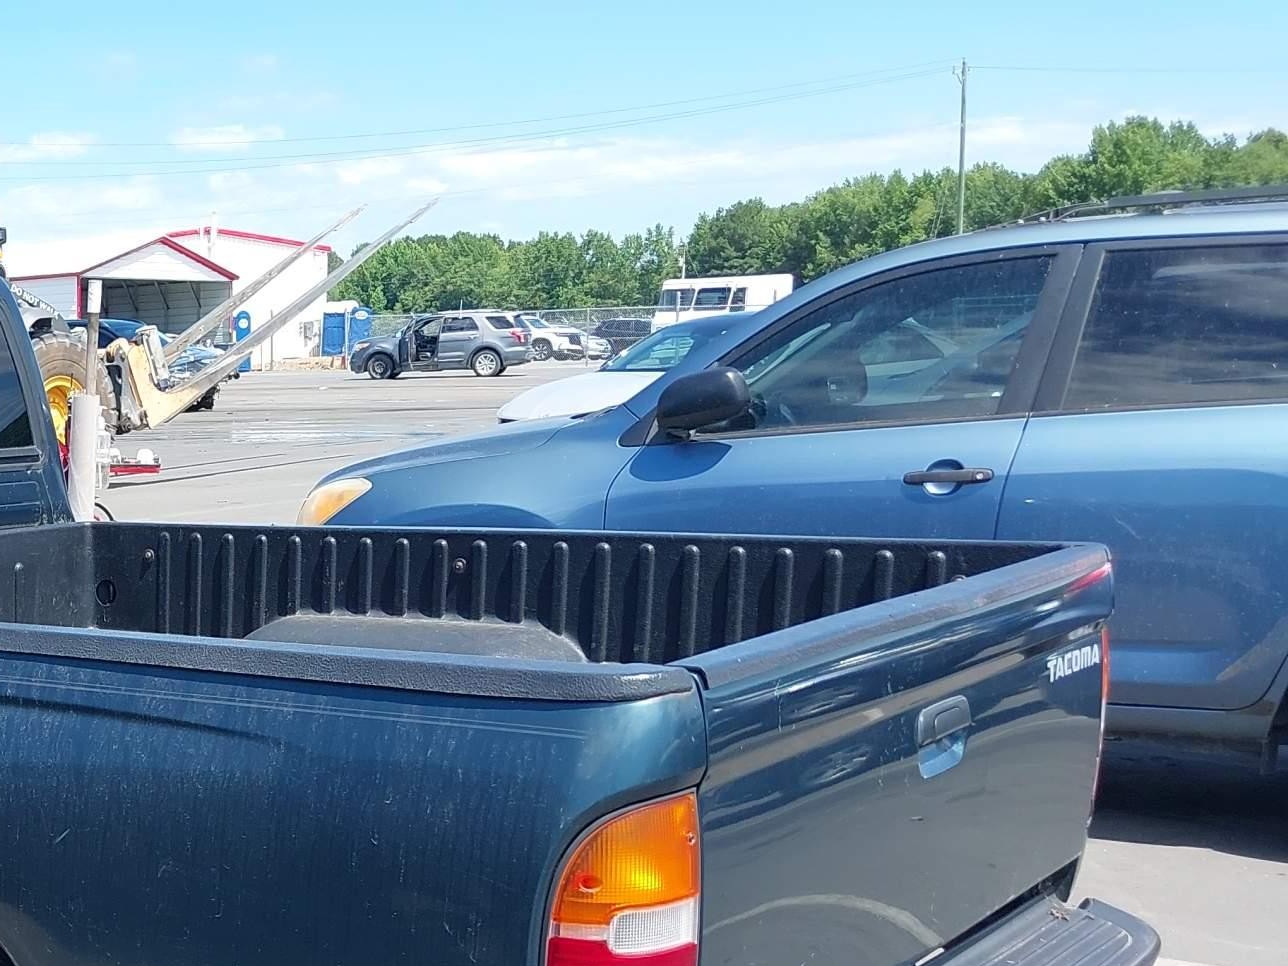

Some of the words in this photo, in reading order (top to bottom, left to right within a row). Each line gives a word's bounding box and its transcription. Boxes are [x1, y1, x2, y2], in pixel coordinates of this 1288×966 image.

[11, 283, 23, 296] DO
[23, 291, 39, 306] NOT
[1046, 643, 1101, 684] TACOMA
